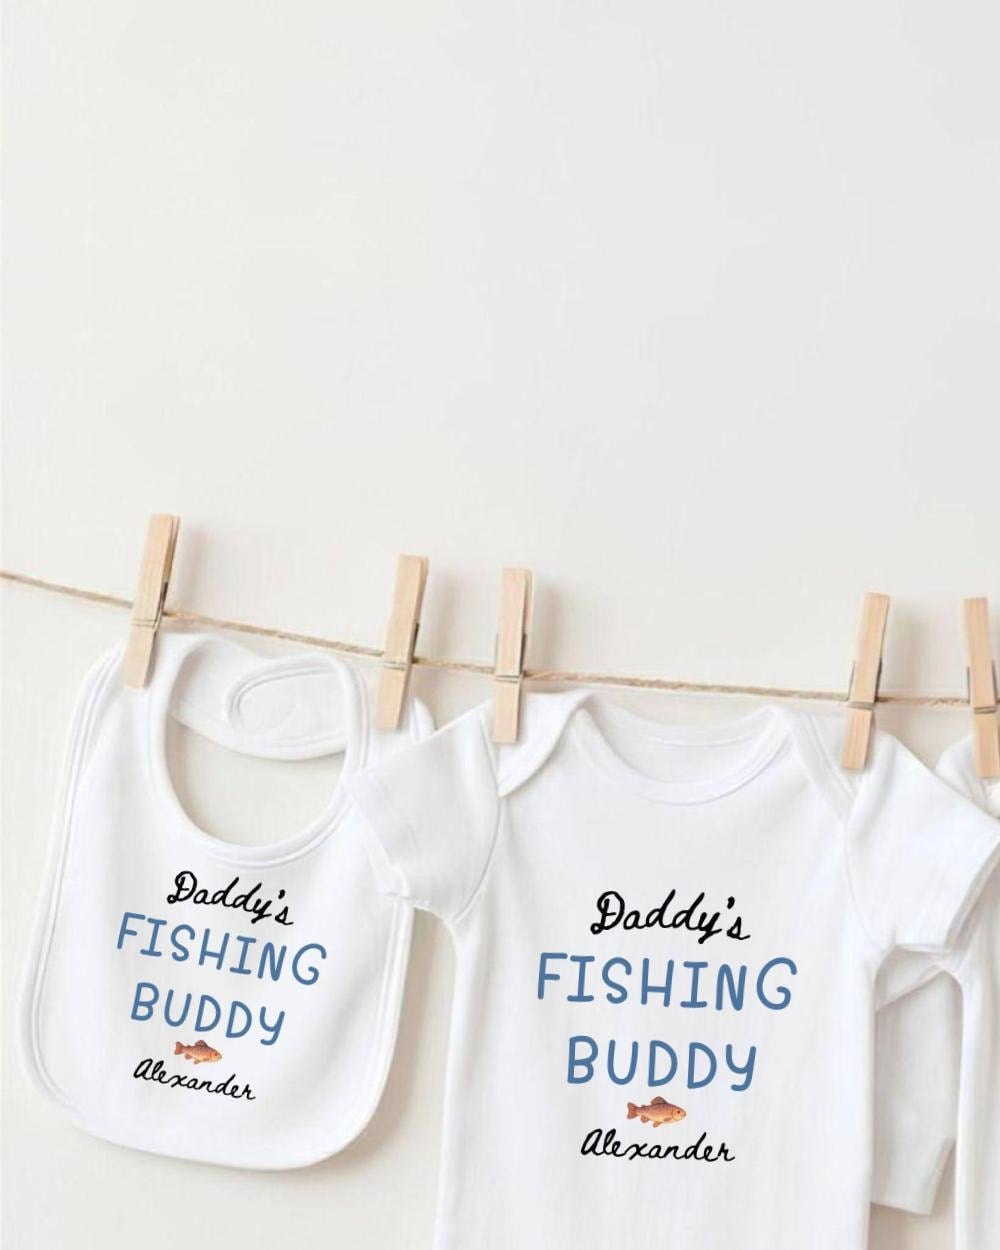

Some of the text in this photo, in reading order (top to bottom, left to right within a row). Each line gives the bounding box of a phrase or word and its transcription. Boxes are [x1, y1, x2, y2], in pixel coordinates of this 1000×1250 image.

[166, 870, 294, 926] Daddy's
[590, 889, 751, 945] Daddy's
[117, 911, 326, 986] FISHING
[538, 951, 797, 1011] FISHING
[131, 981, 285, 1045] BUDDY
[133, 1058, 256, 1101] Alexander
[567, 1035, 756, 1092] BUDDY
[580, 1128, 736, 1163] Alexander
